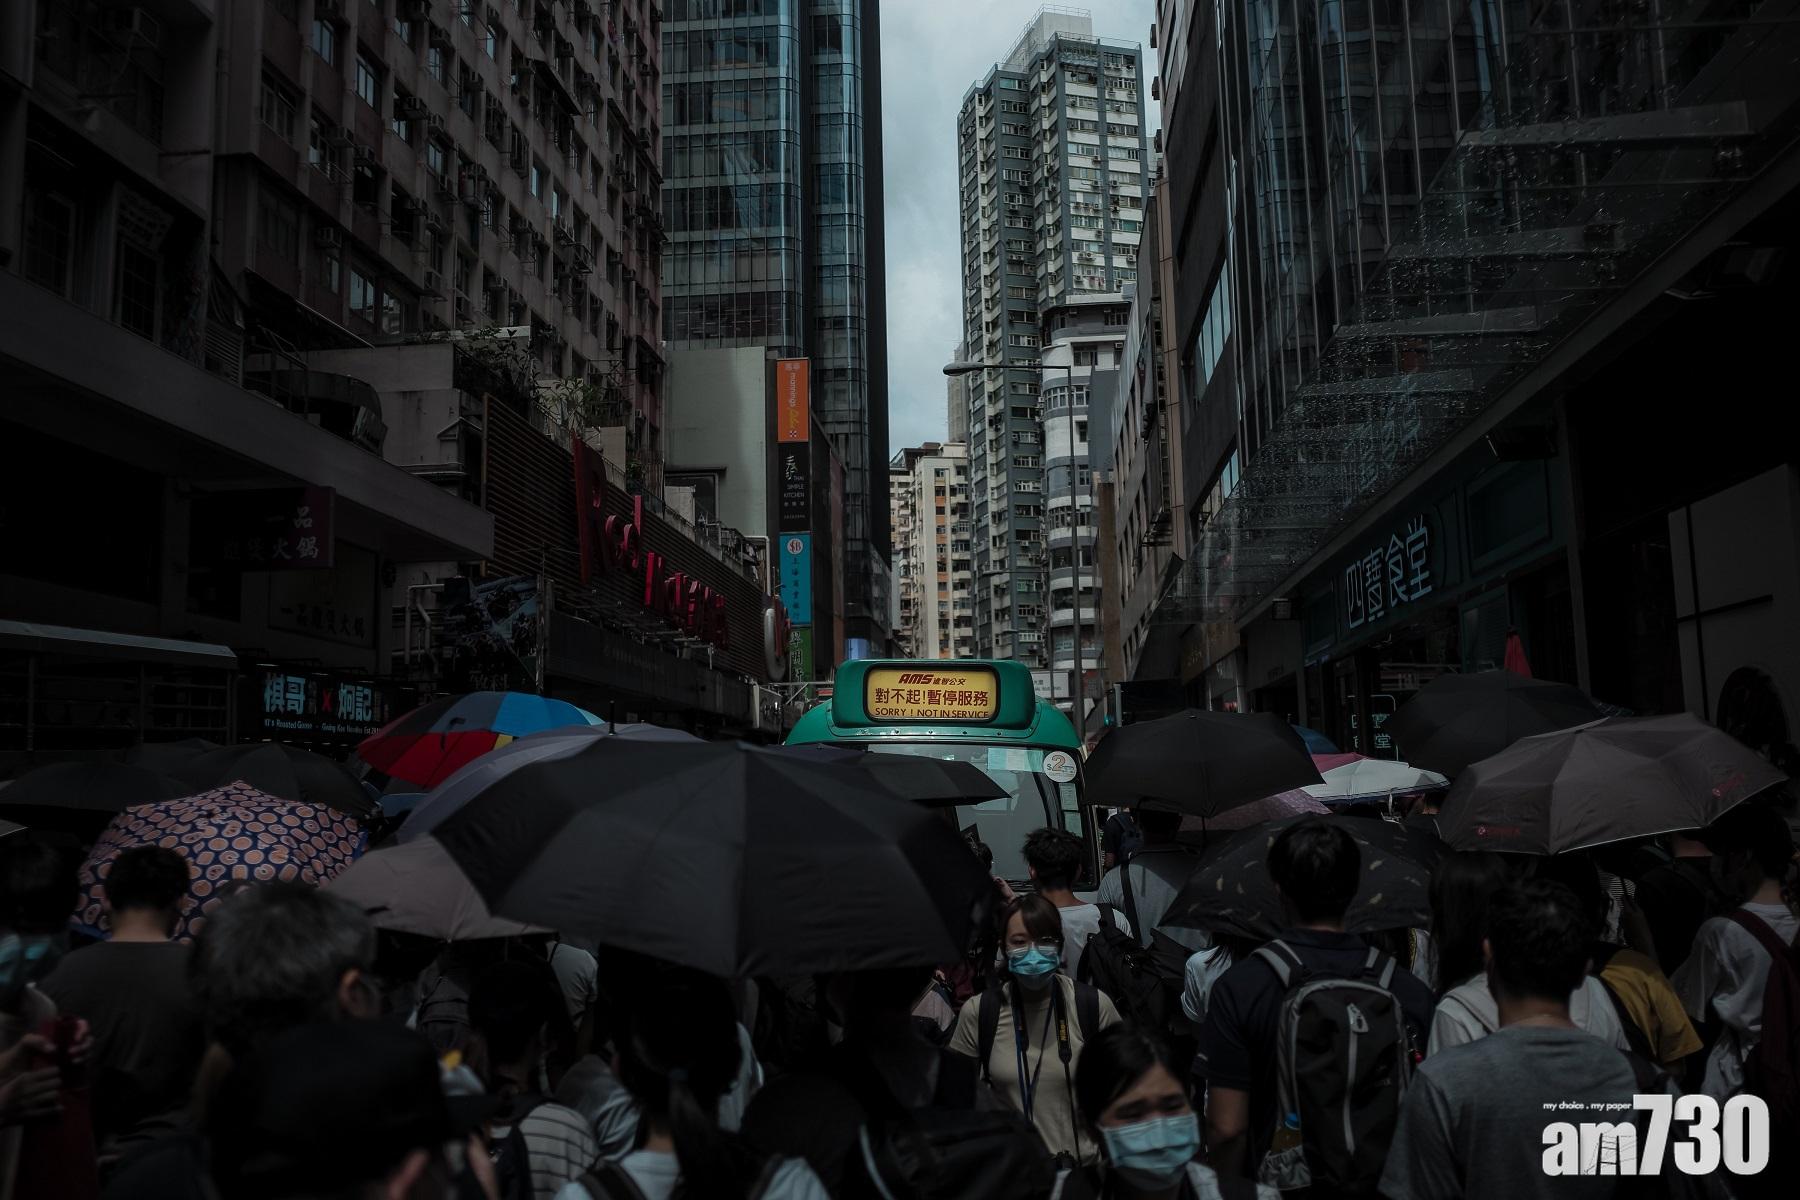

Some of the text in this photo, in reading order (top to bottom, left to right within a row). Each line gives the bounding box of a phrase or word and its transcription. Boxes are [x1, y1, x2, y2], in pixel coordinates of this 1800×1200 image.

[1346, 514, 1433, 629] 四寶食堂
[898, 673, 935, 685] AMS
[875, 708, 906, 717] SORRY
[917, 709, 940, 718] NOT
[940, 710, 951, 718] IN
[951, 710, 989, 718] SERVICE
